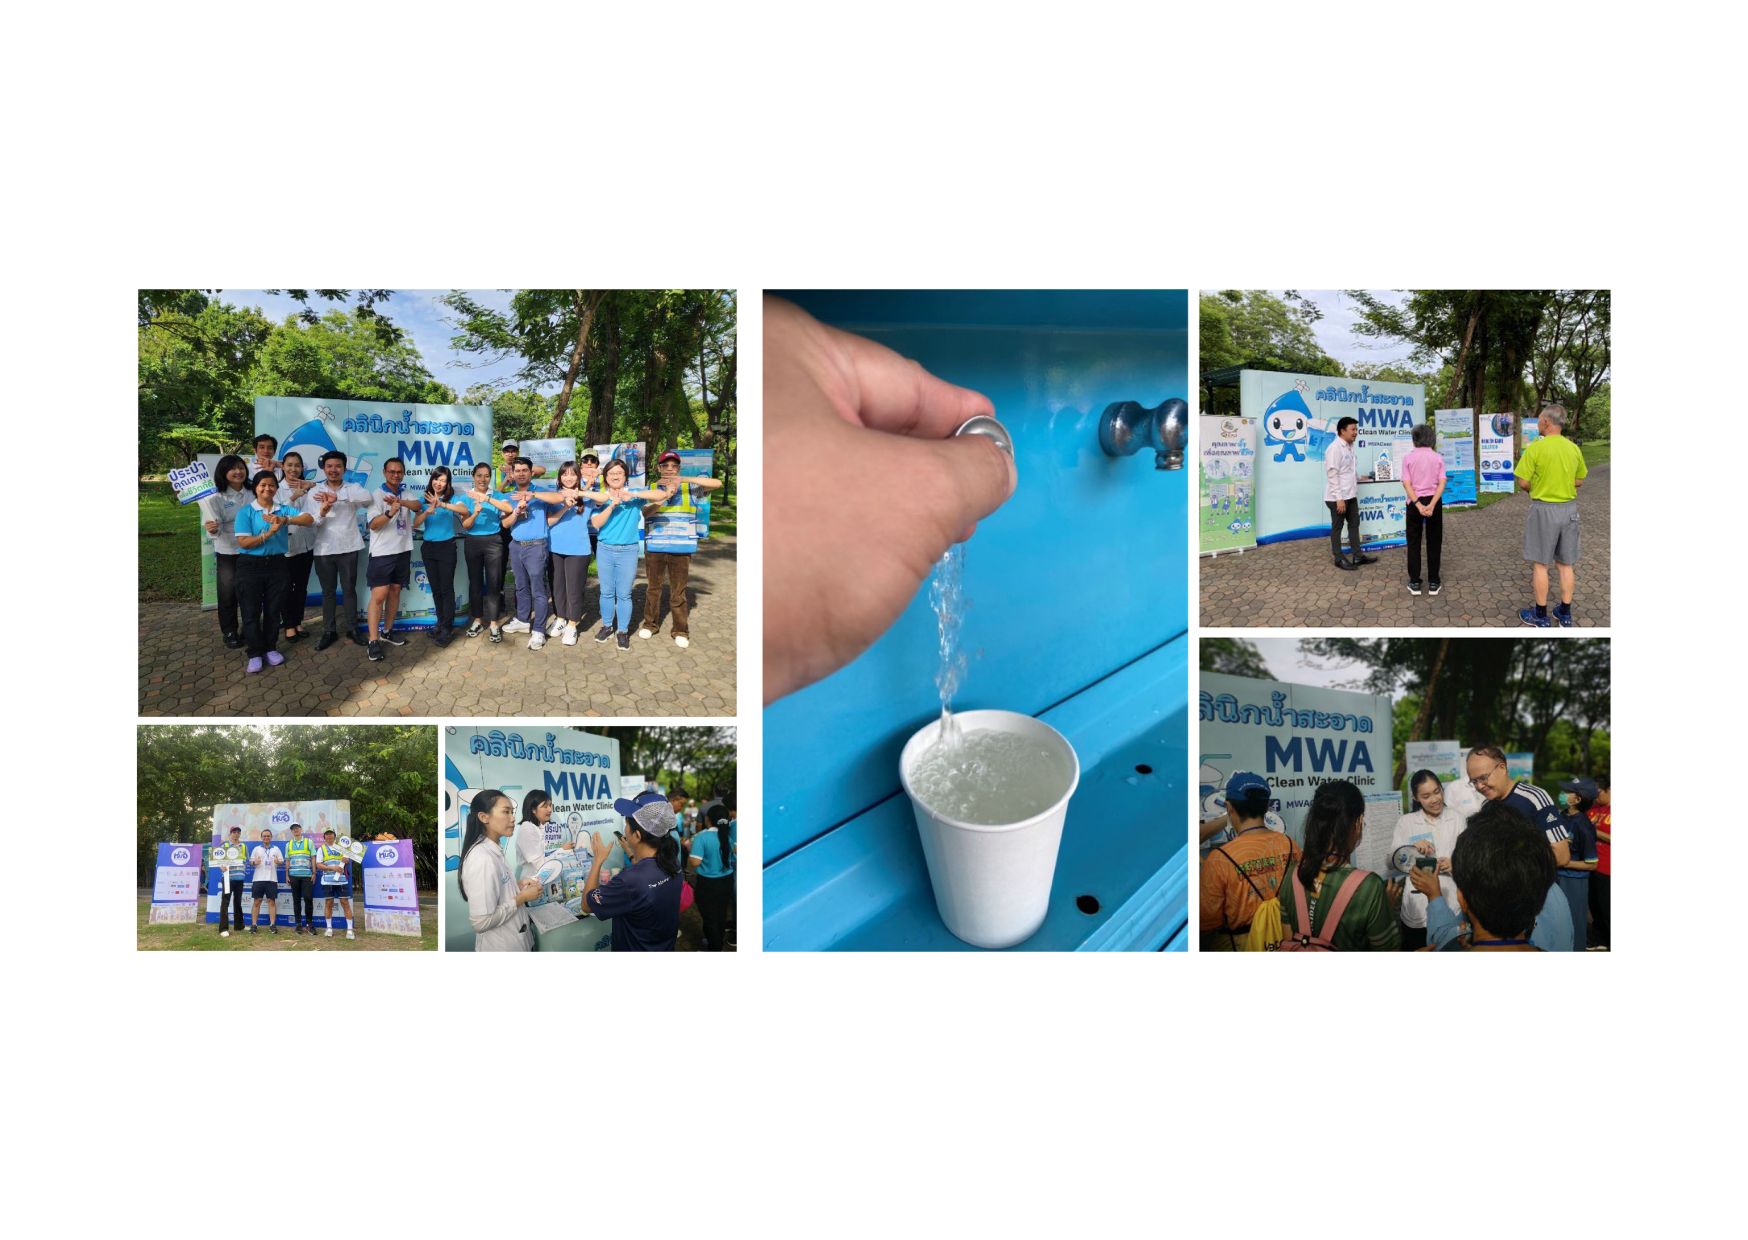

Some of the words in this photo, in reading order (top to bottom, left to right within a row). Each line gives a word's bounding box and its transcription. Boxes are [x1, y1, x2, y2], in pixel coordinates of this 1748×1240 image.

[1316, 384, 1414, 406] คลินิกน้ำสะอาด
[342, 410, 475, 436] คลินิกน้ำสะอาด
[1358, 408, 1414, 429] MWA
[398, 440, 475, 466] MWA
[169, 462, 207, 482] ประปา
[173, 471, 209, 491] คุณภาพ
[1199, 690, 1373, 733] ลินิกน้ำสะอาด
[470, 730, 611, 768] คลินิกน้ำสะอาด
[1265, 735, 1374, 773] MWA
[543, 770, 613, 801] MWA
[1266, 776, 1304, 788] Clean
[1346, 775, 1376, 786] Clinic
[552, 803, 571, 813] lean
[573, 802, 595, 812] Water
[596, 801, 614, 810] Clinic
[544, 823, 562, 834] ประปา
